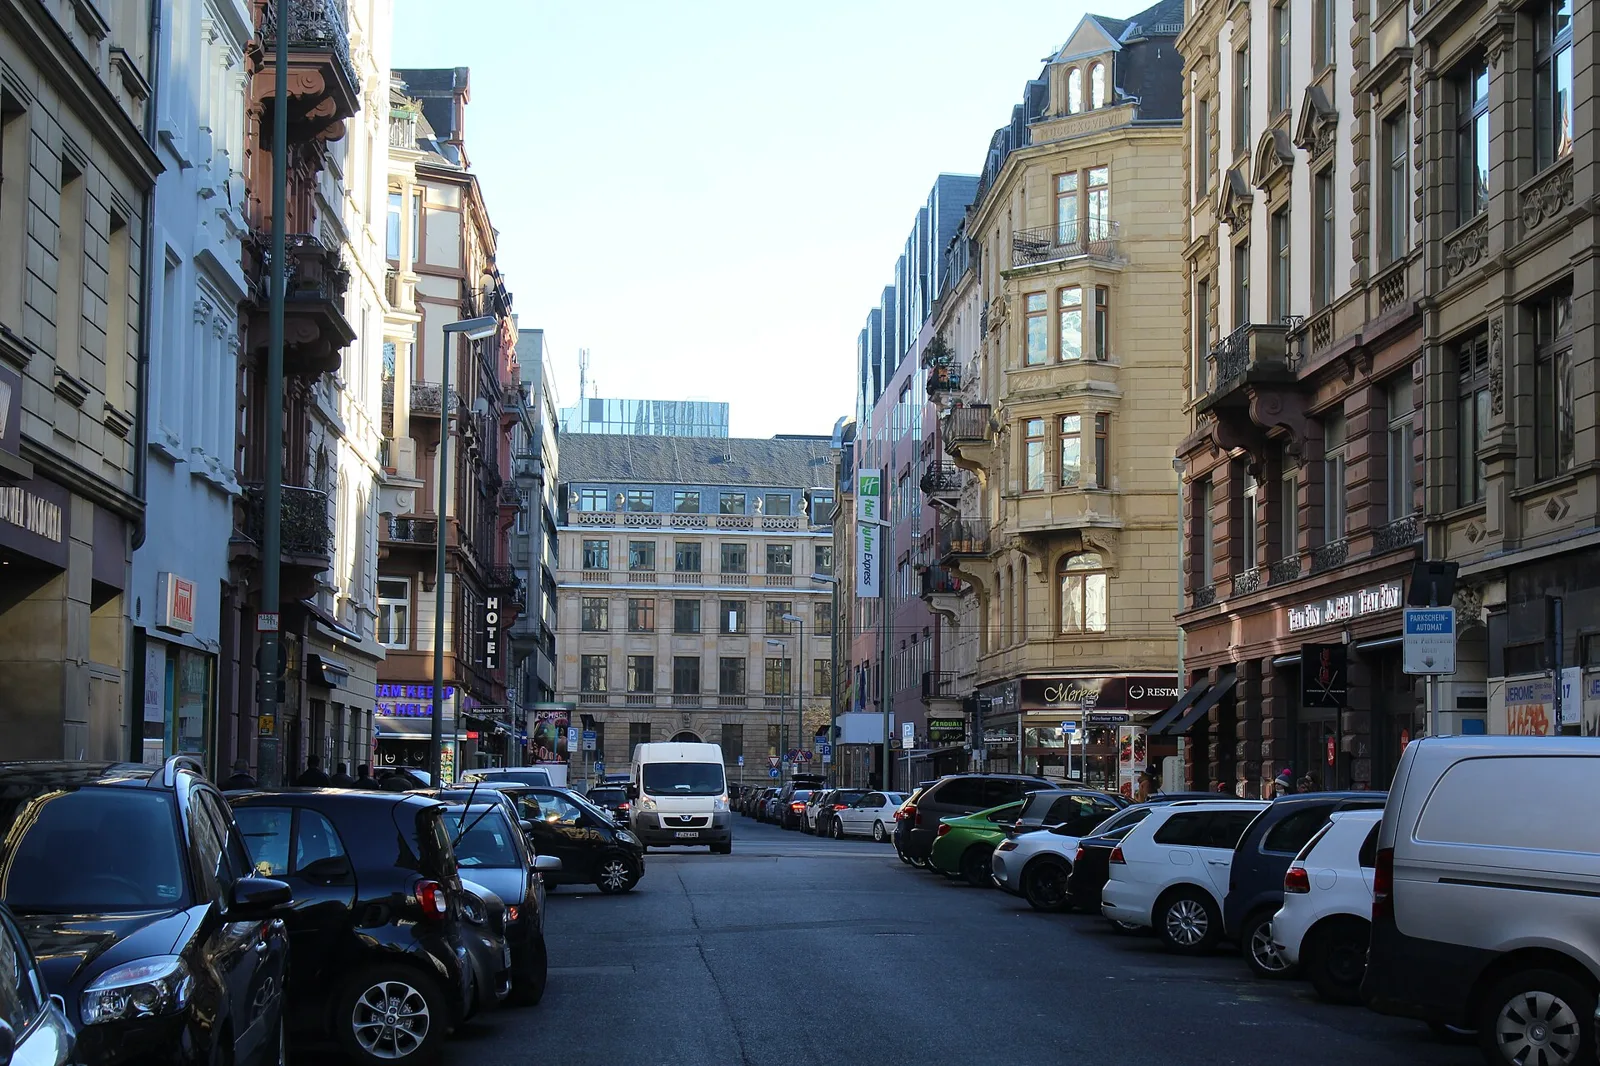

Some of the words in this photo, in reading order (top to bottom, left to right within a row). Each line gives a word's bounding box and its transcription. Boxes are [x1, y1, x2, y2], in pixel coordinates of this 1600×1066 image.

[862, 499, 875, 537] Holiy
[864, 537, 874, 552] Inn
[862, 552, 873, 586] Express
[1358, 589, 1379, 614] THAI
[1379, 583, 1399, 610] FUN
[1410, 614, 1449, 622] PARKSCHEIN-
[486, 597, 498, 669] HOTEL
[1416, 623, 1443, 631] AUTOMAT
[406, 685, 455, 699] KEBP
[1505, 685, 1534, 702] JEROME
[1562, 683, 1571, 699] 17
